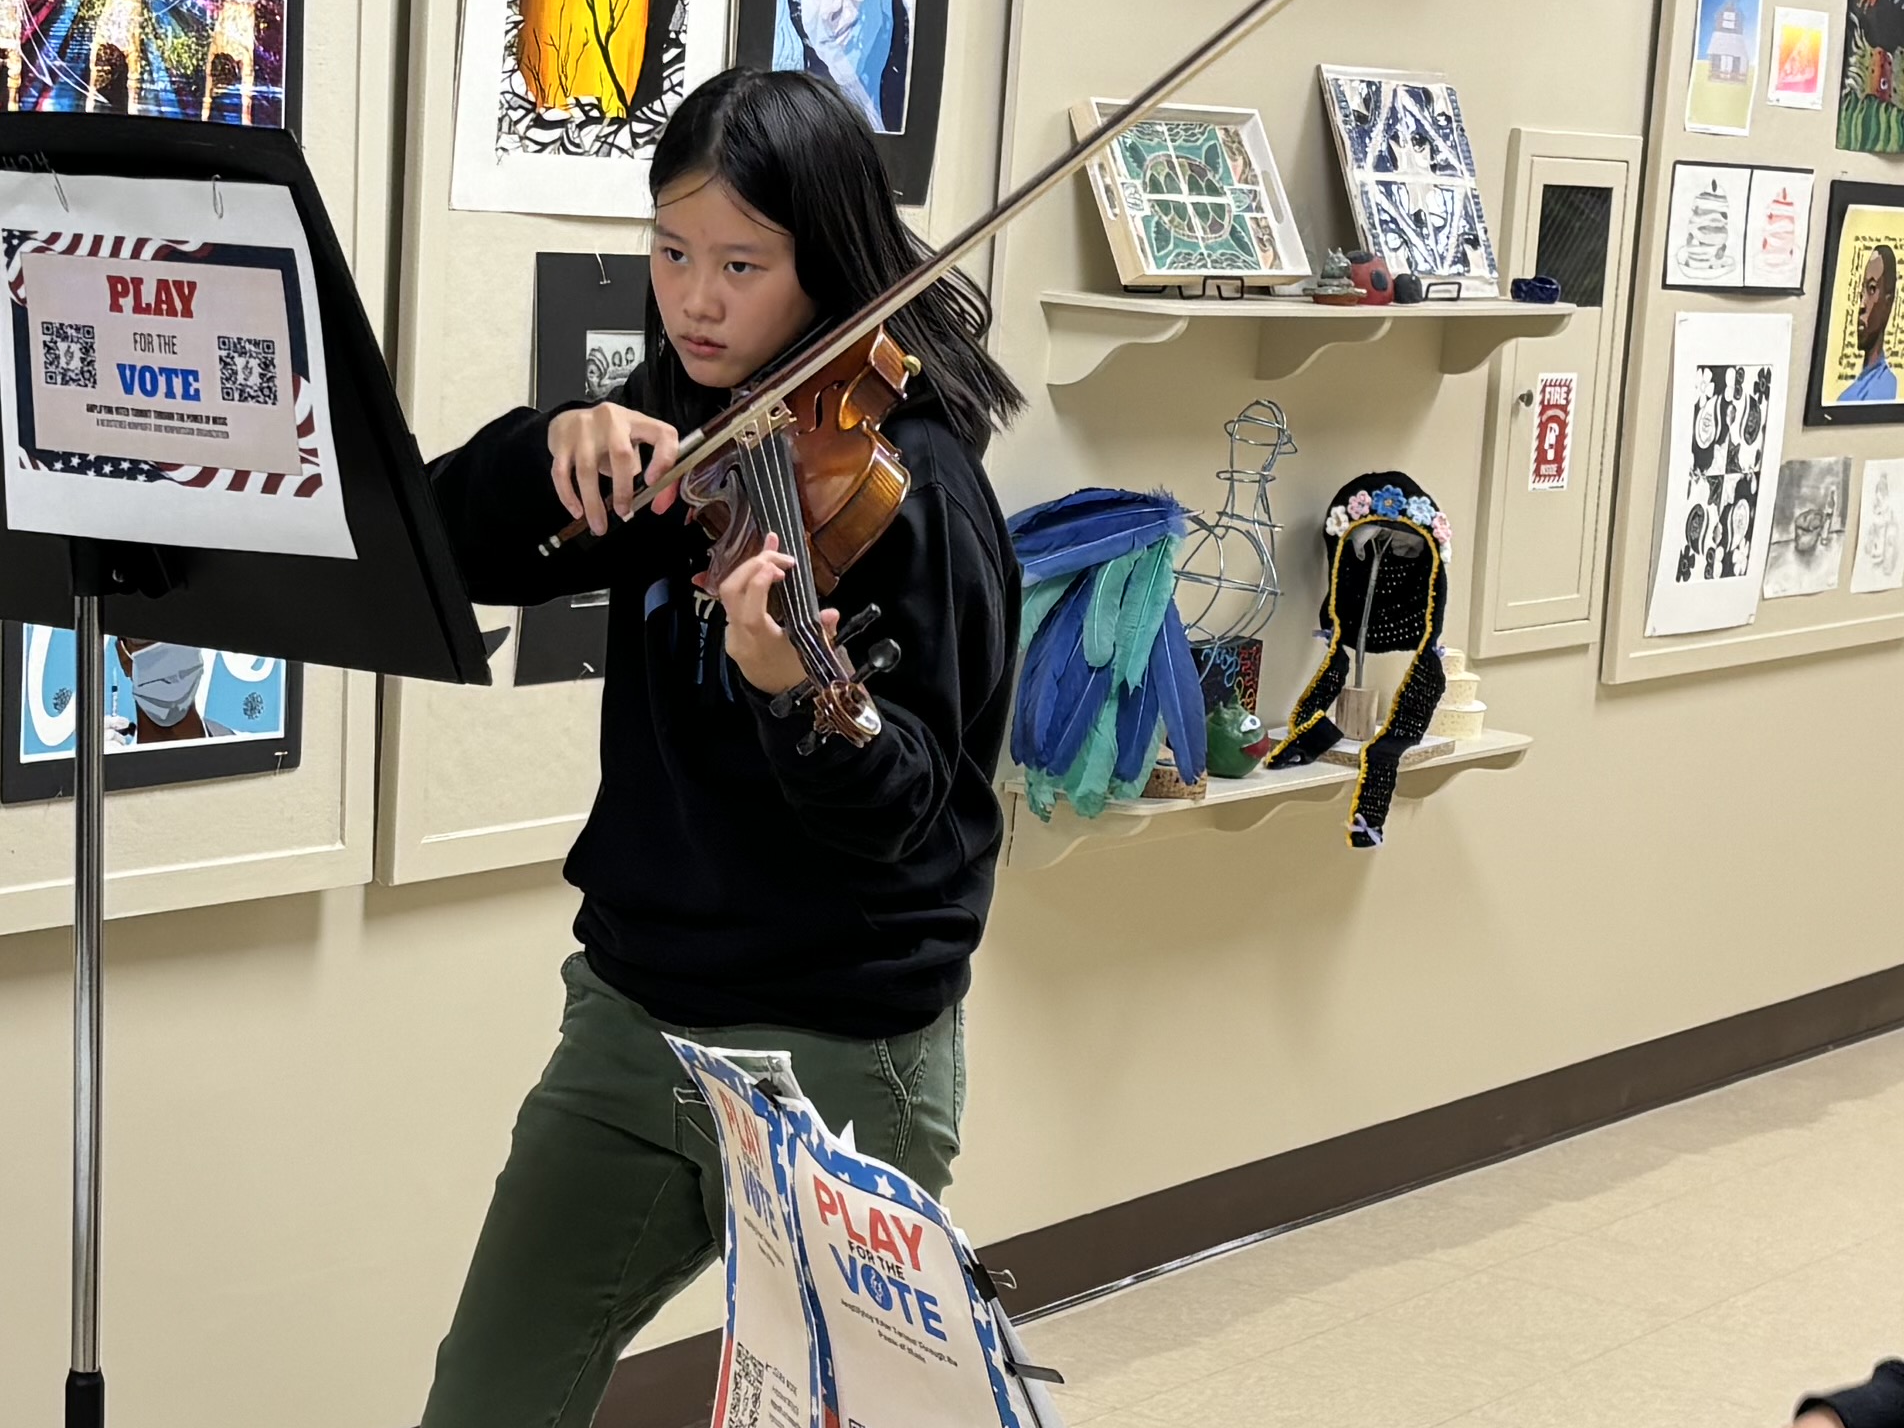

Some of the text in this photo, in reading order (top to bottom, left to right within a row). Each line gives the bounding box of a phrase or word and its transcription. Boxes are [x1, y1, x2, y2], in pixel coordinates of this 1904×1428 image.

[106, 274, 197, 319] PLAY
[133, 331, 178, 355] FOR THE
[116, 362, 202, 402] VOTE
[1543, 386, 1569, 406] FIRE
[717, 1087, 764, 1169] PLAY
[737, 1155, 780, 1241] VOTE
[813, 1174, 924, 1271] PLAY
[848, 1239, 906, 1281] FOR THE
[828, 1242, 948, 1342] VOTE
